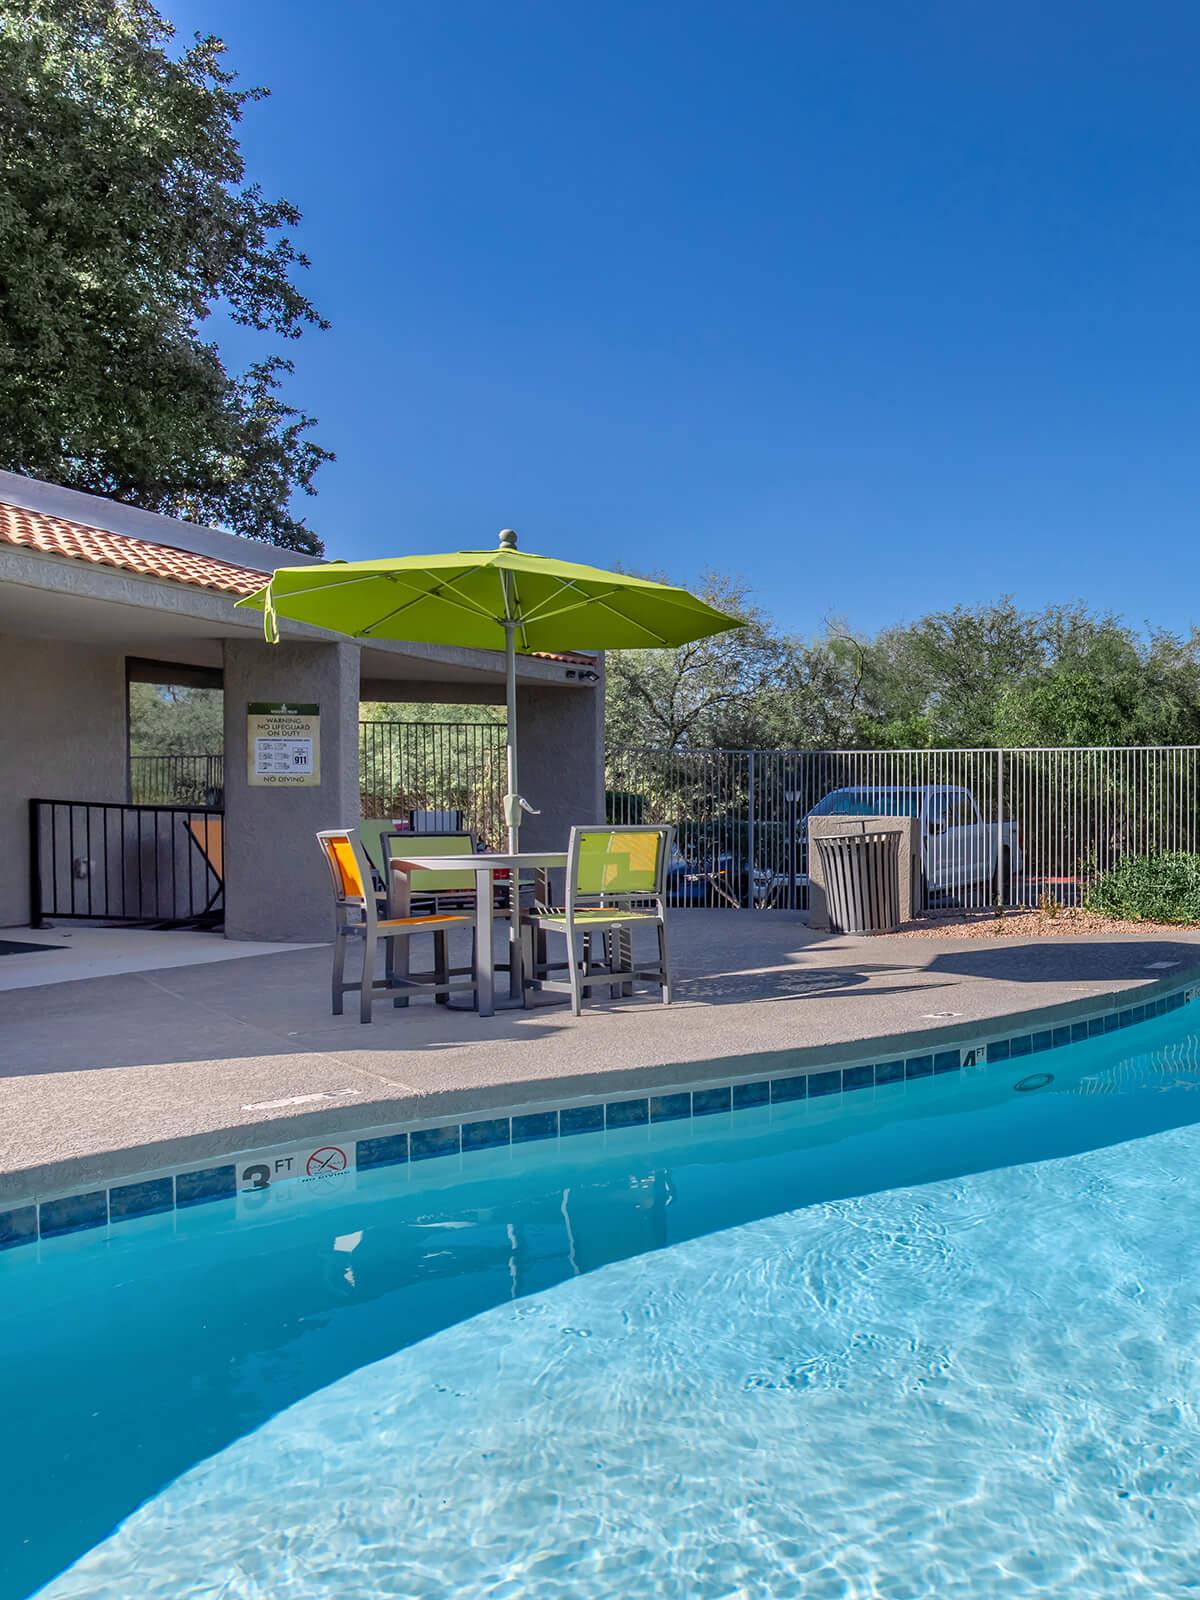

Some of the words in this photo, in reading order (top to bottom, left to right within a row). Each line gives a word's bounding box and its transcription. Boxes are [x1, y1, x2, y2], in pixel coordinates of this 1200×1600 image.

[294, 755, 307, 764] 911
[976, 1047, 985, 1057] FT
[241, 1164, 271, 1193] 3
[275, 1157, 294, 1173] FT
